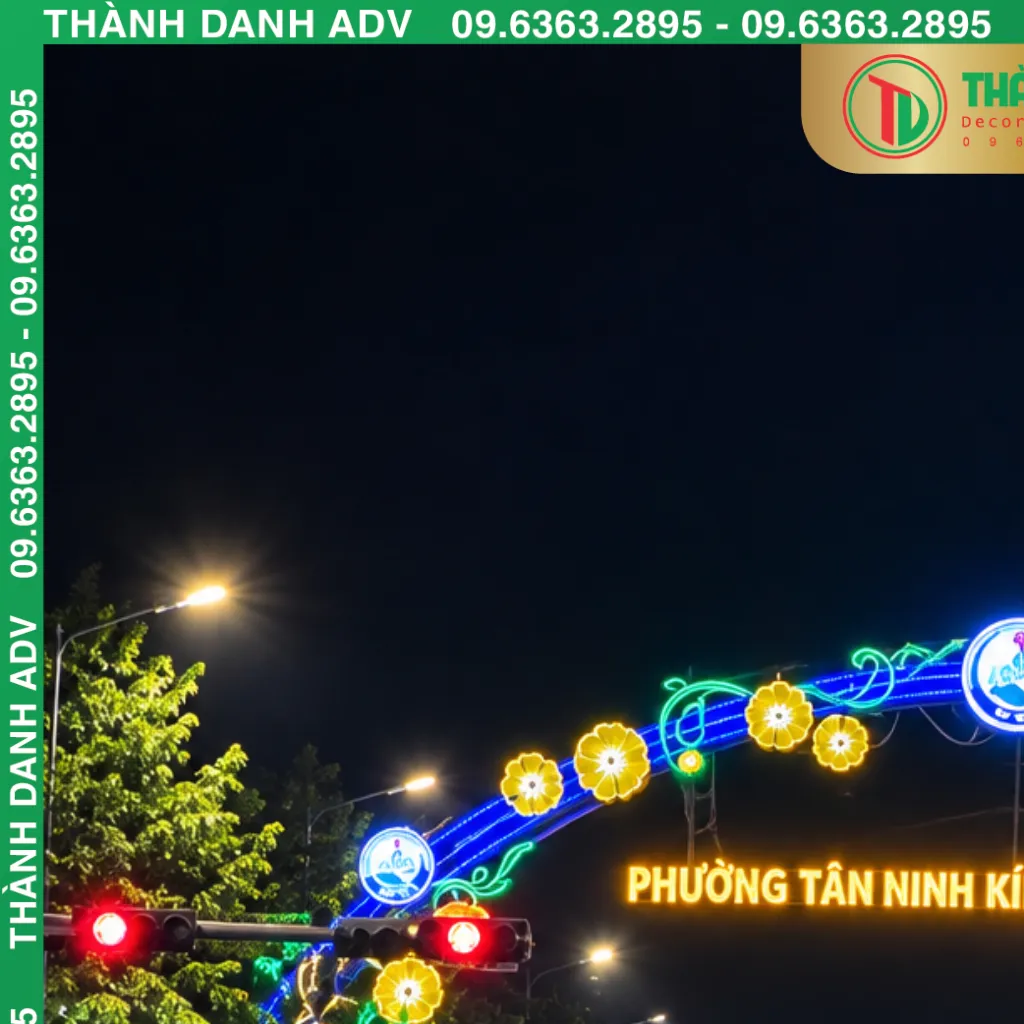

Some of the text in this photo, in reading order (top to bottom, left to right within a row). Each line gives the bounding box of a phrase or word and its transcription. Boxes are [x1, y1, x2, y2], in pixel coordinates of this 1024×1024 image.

[627, 858, 788, 905] PHƯỜNG
[798, 860, 874, 906] TÂN
[883, 870, 974, 909] NINH
